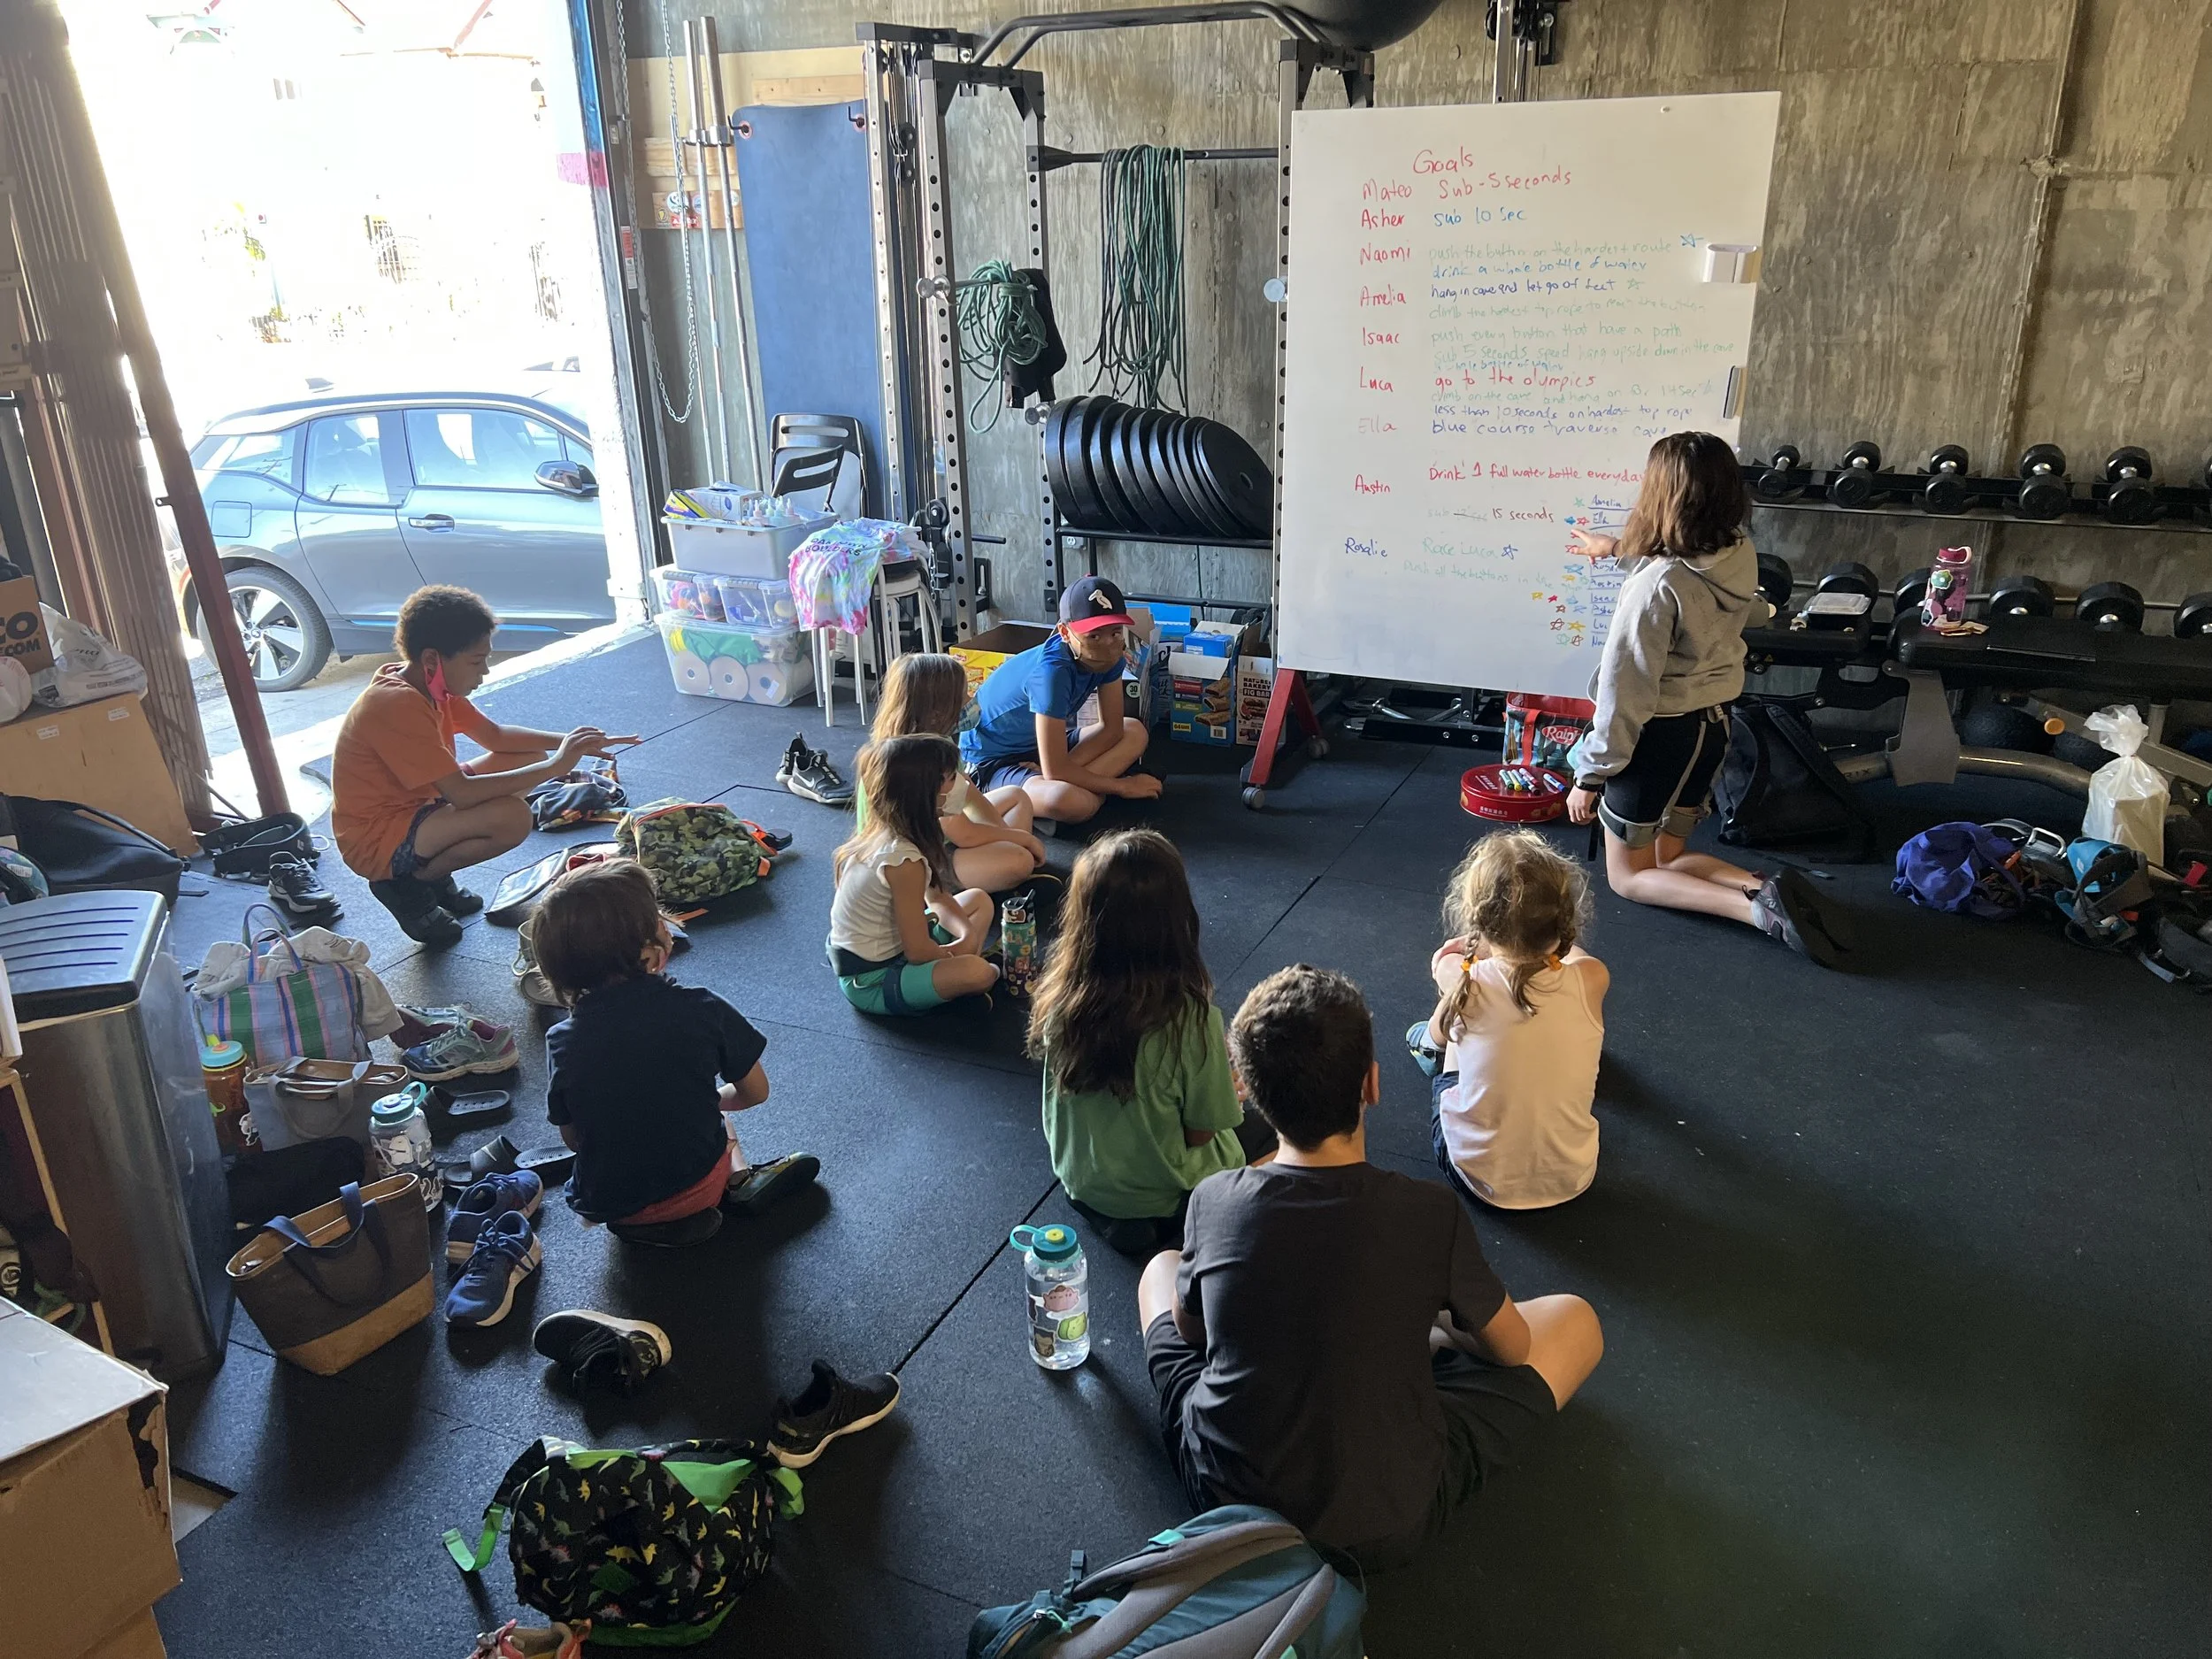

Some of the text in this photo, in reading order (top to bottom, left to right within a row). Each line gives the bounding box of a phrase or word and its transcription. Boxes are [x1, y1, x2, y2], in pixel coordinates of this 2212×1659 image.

[1412, 145, 1474, 174] Goals
[1363, 178, 1413, 203] Mateo
[1361, 208, 1406, 230] Asher
[1433, 208, 1463, 227] sub
[1475, 206, 1492, 225] 10
[1360, 241, 1411, 265] Naomi
[1533, 248, 1548, 257] on
[1632, 239, 1672, 254] route
[1478, 265, 1488, 275] a
[1360, 283, 1407, 308] Amelia
[1431, 283, 1457, 302] hang
[1460, 285, 1470, 296] in
[1527, 279, 1542, 293] let
[1546, 281, 1560, 296] go
[1363, 326, 1402, 347] Isaac
[1563, 323, 1588, 334] that
[1599, 320, 1627, 334] have
[1463, 343, 1476, 357] 5
[1359, 365, 1597, 393] Luca go to the olympics
[1358, 414, 1397, 434] Ella
[1432, 419, 1468, 434] blue
[1477, 423, 1536, 434] course
[1434, 404, 1456, 417] less
[1461, 405, 1490, 417] than
[1496, 404, 1511, 420] 10
[1513, 406, 1558, 420] seconds
[1568, 410, 1585, 419] on
[1355, 473, 1391, 495] Austin
[1429, 465, 1466, 480] Drink
[1471, 461, 1482, 477] 1
[1489, 462, 1508, 479] full
[1512, 467, 1545, 478] water
[1548, 466, 1582, 480] bottle
[1492, 507, 1503, 520] 15
[1509, 506, 1555, 523] seconds
[1344, 536, 1388, 558] Rosalie
